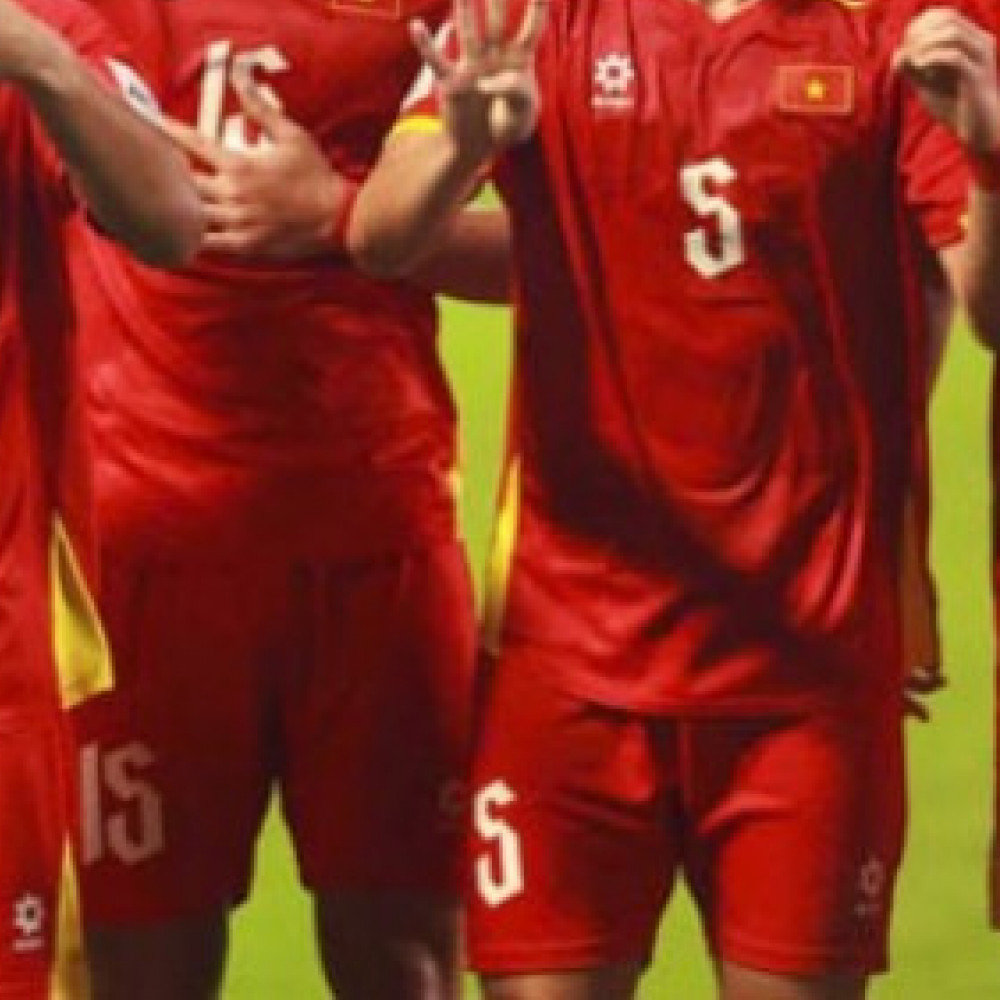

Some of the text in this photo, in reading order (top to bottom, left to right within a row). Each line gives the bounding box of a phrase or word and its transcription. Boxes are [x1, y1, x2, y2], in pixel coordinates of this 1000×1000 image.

[680, 158, 744, 278] 5
[80, 742, 164, 866] 15
[472, 779, 525, 908] 5
